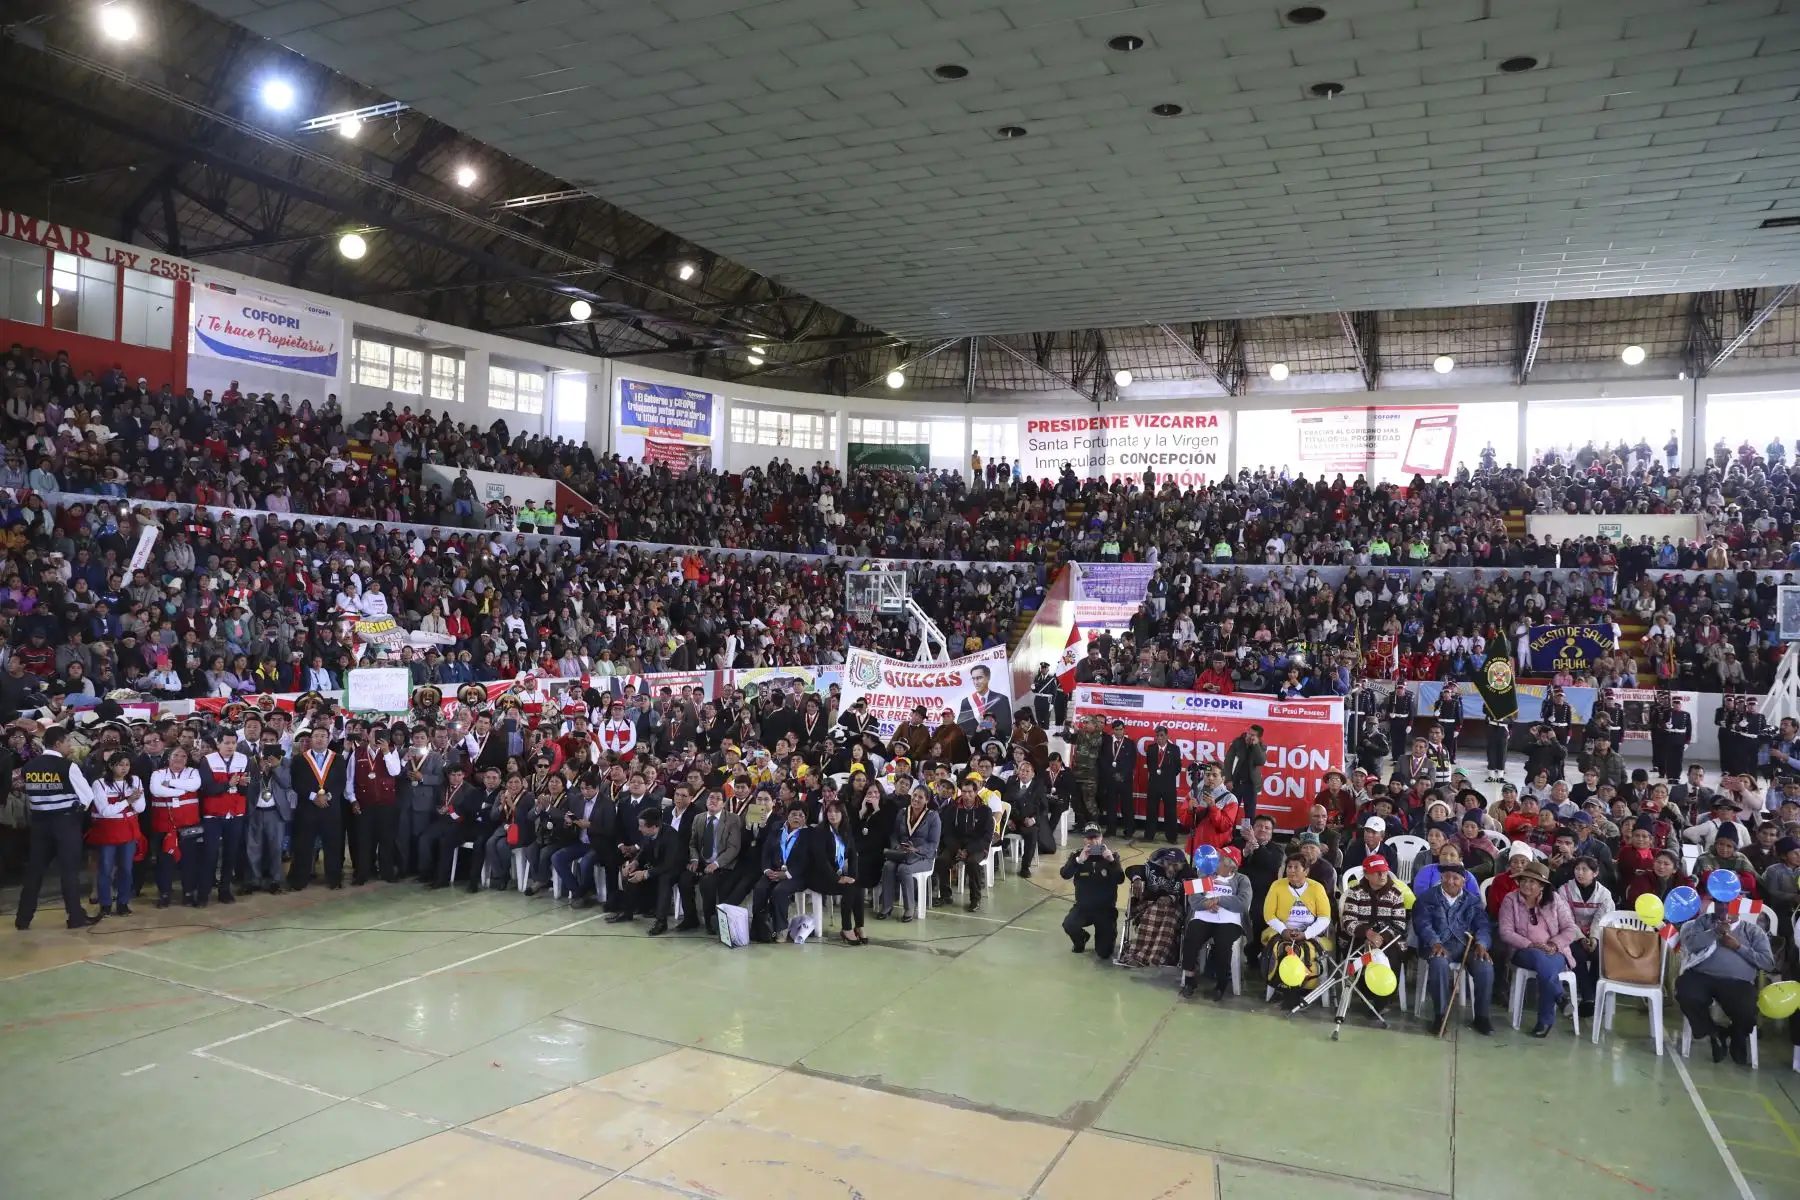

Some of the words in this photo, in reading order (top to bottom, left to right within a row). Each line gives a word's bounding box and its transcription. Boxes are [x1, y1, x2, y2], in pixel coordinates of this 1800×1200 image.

[104, 247, 141, 269] LEY
[242, 307, 300, 330] COFOPRI
[208, 316, 221, 332] Te
[224, 320, 256, 339] hace
[258, 327, 326, 353] Propietario
[1027, 414, 1129, 433] PRESIDENTE
[1133, 414, 1218, 428] VIZCARRA
[1029, 438, 1068, 451] Santa
[1073, 436, 1139, 449] Fortunata
[1143, 436, 1151, 449] y
[1156, 433, 1167, 446] la
[1172, 434, 1219, 450] Virgen
[1035, 453, 1114, 469] Inmaculada
[1120, 450, 1216, 465] CONCEPCIÓN
[1530, 627, 1565, 652] PUESTO
[1567, 626, 1581, 637] DE
[1582, 627, 1614, 651] SALUD
[993, 649, 1005, 660] DE
[884, 670, 963, 689] QUILCAS
[864, 692, 944, 709] BIENVENIDO
[1186, 696, 1242, 710] COFOPRI
[1153, 720, 1160, 729] y
[25, 772, 60, 783] POLICIA
